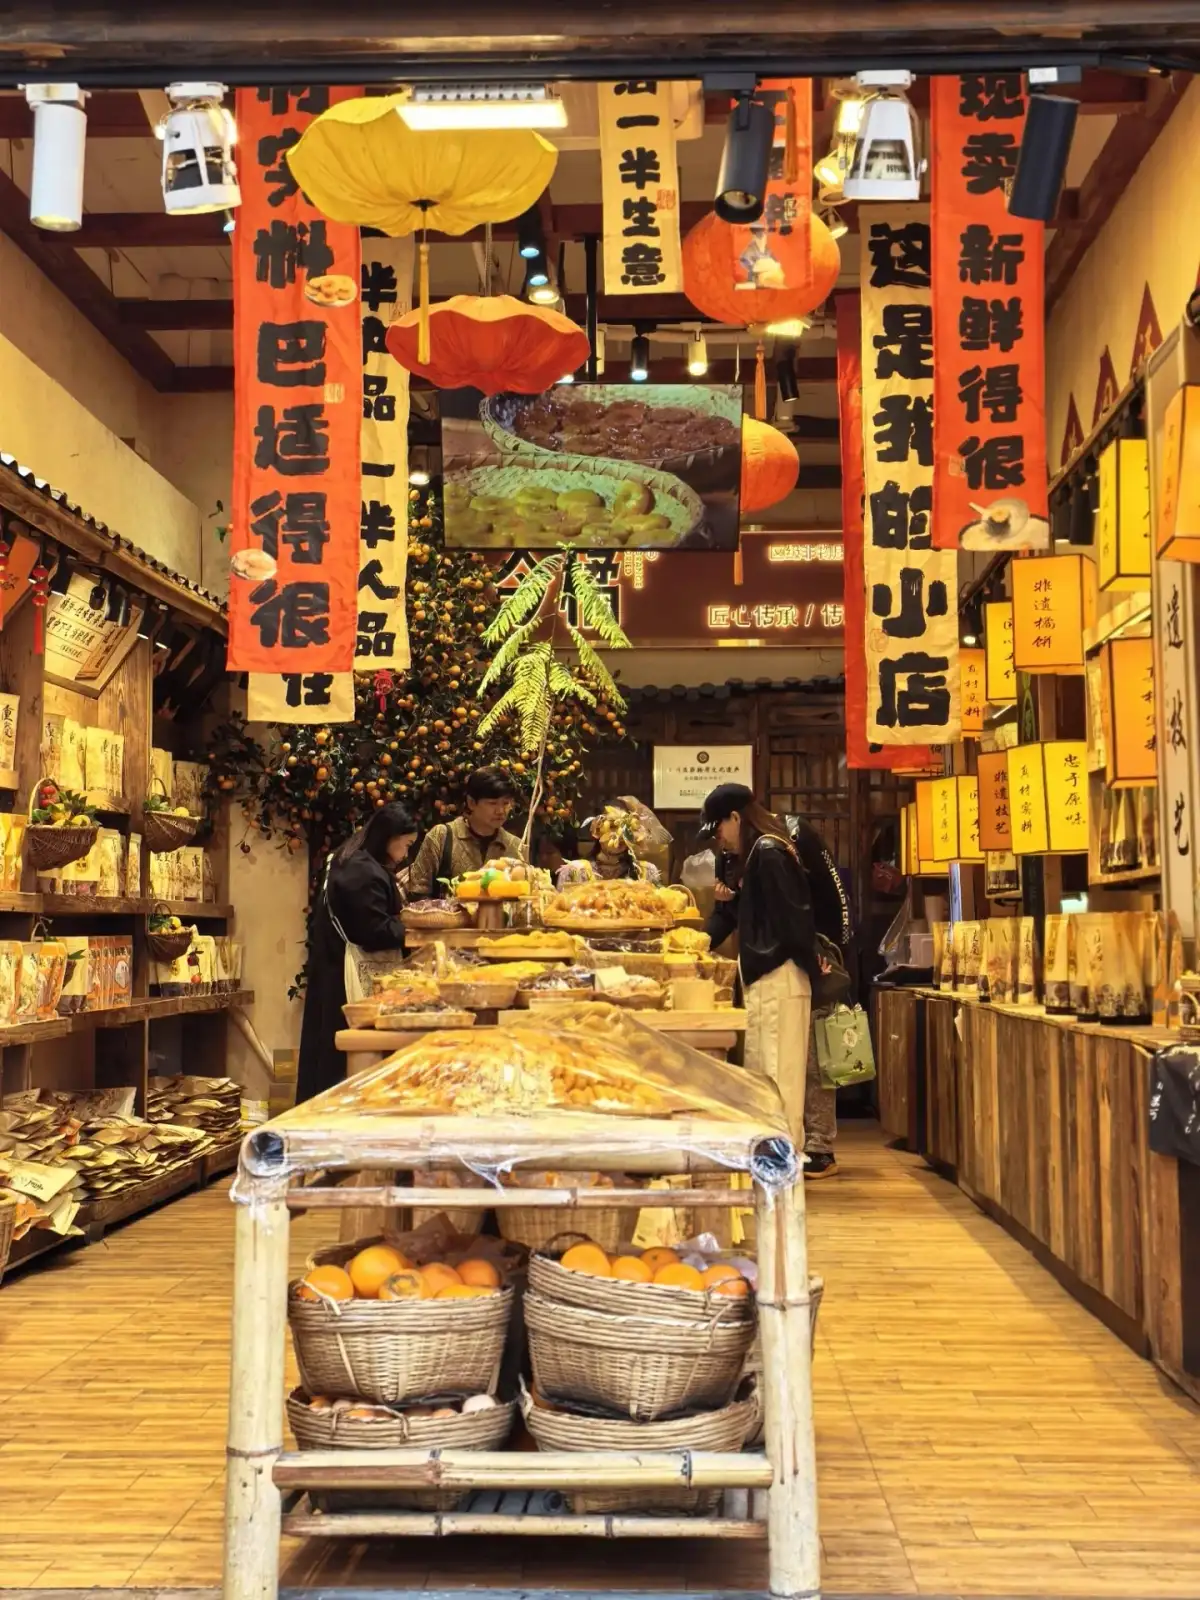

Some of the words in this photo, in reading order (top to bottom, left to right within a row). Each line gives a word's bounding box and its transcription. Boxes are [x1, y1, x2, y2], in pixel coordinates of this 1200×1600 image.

[868, 222, 951, 728] 这是我的小店
[708, 604, 799, 628] 匠心传承
[1063, 753, 1086, 825] 忠于原味
[829, 866, 850, 927] HOLLISTER
